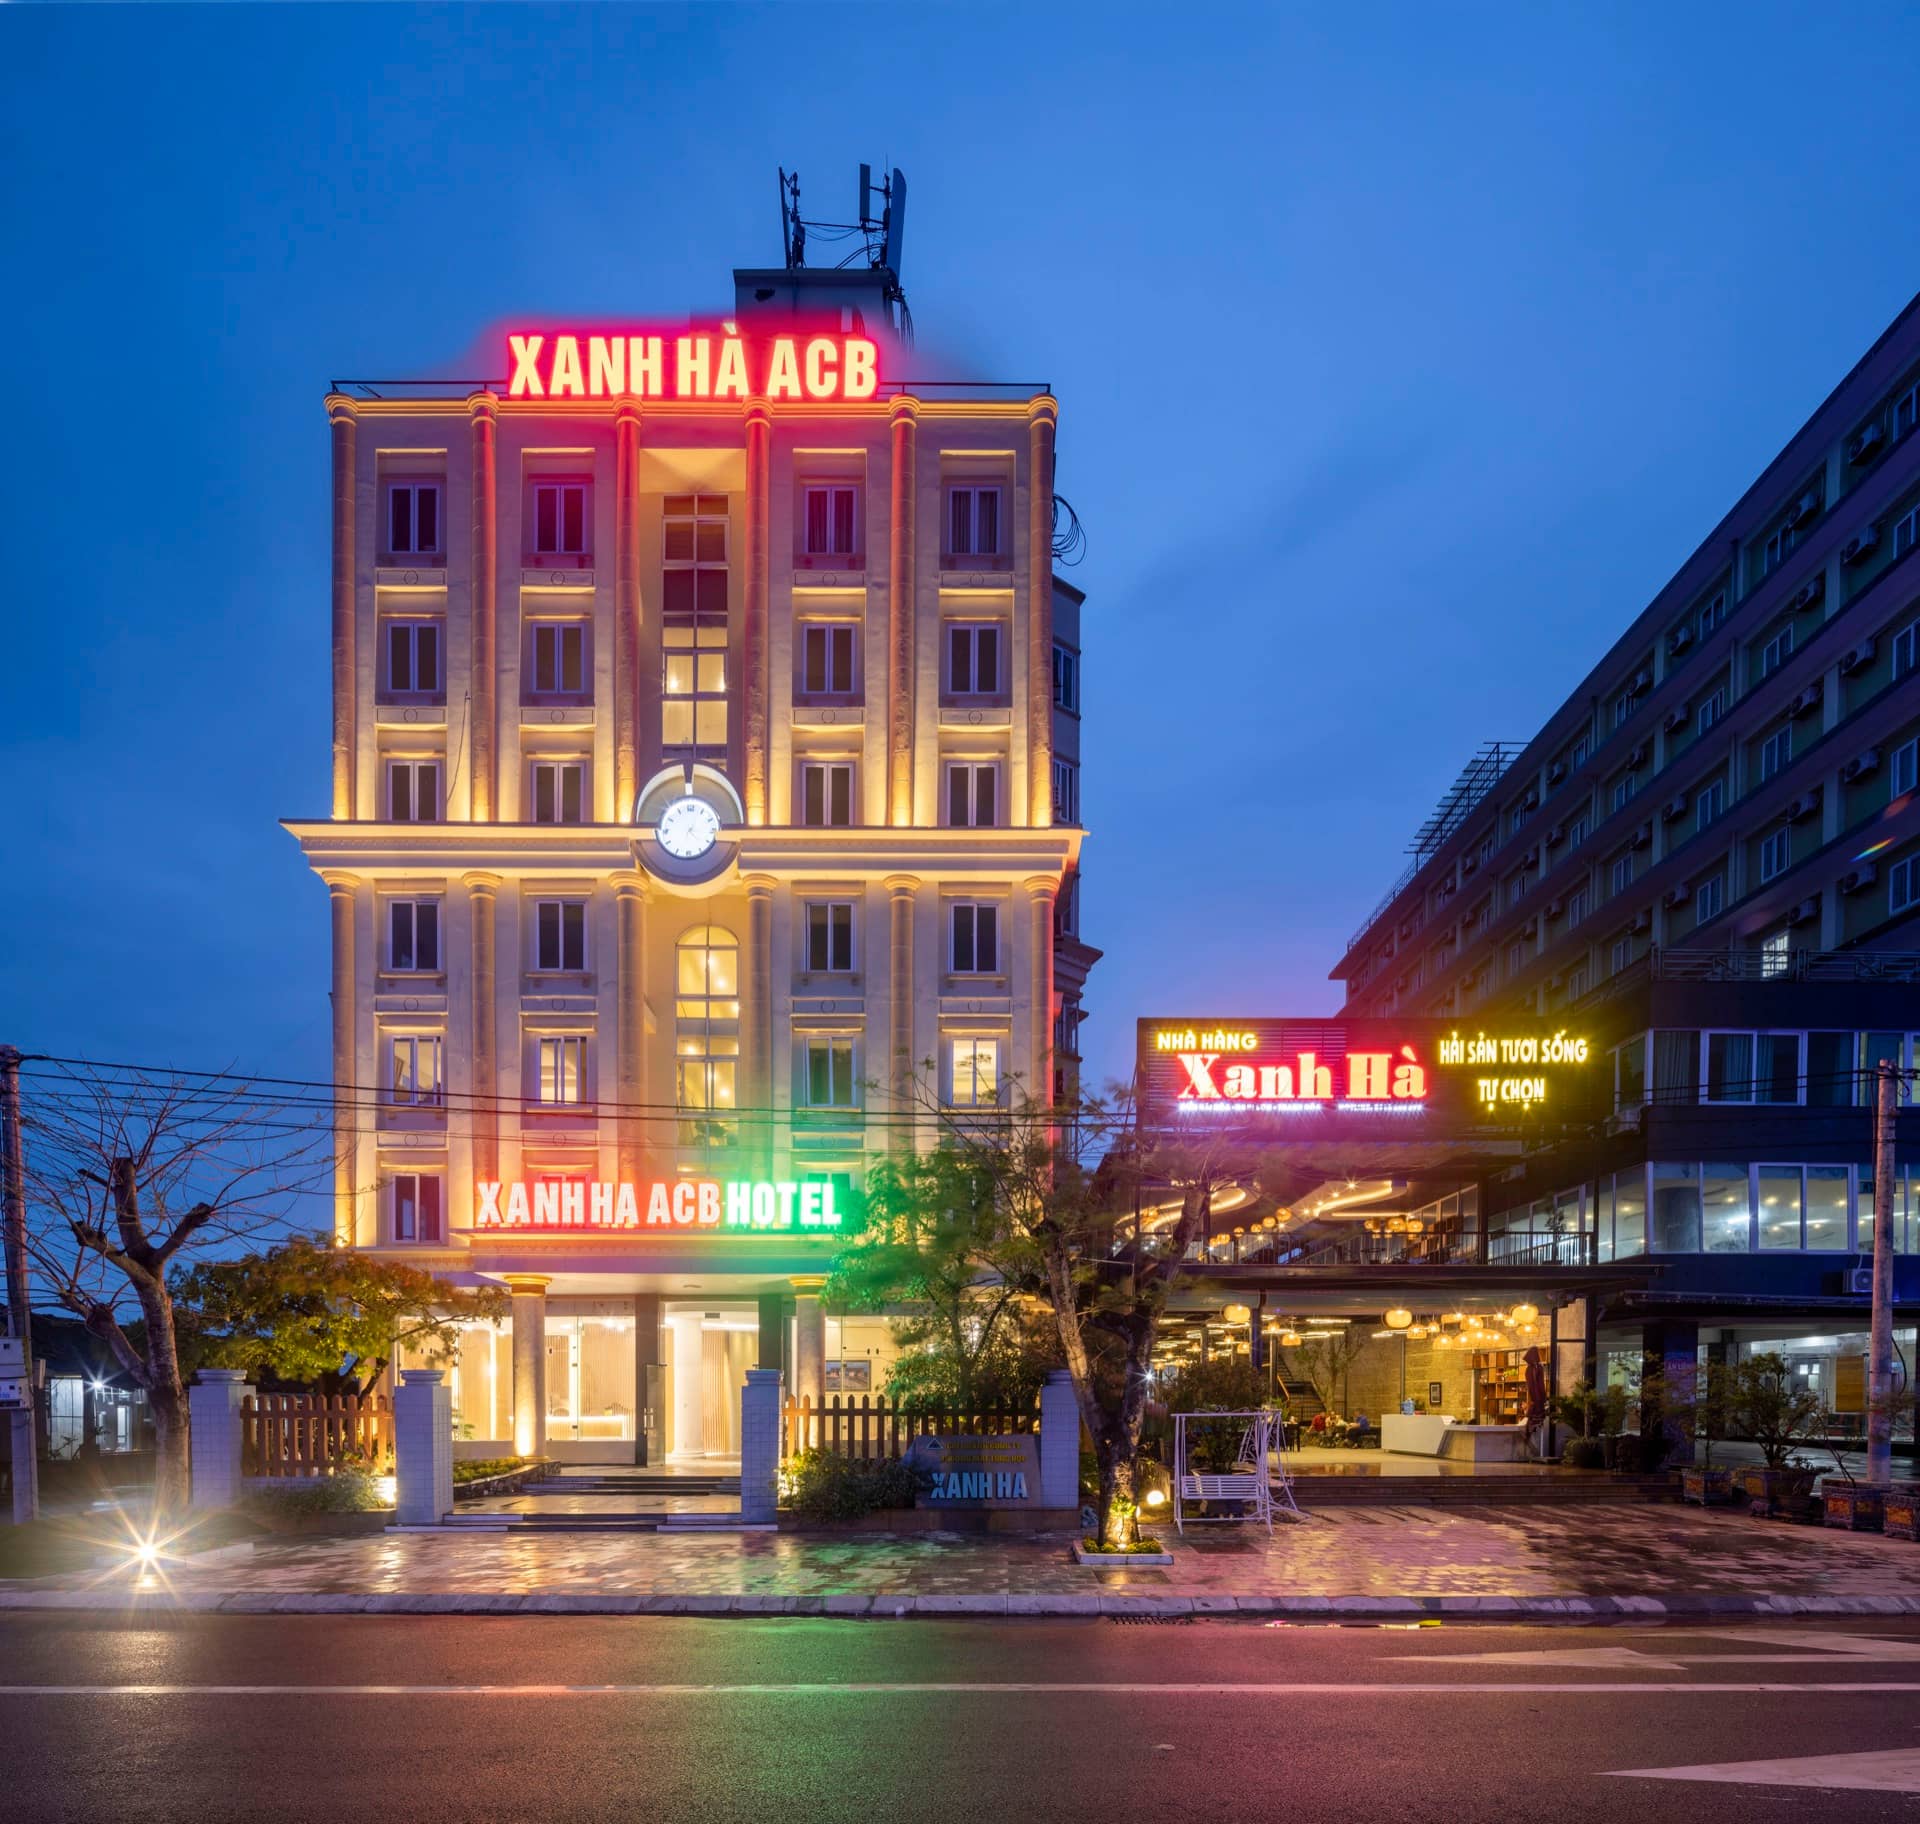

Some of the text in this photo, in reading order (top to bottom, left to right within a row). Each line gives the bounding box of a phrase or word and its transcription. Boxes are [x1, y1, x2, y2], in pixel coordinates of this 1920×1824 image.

[508, 322, 878, 398] XANH HÀ ACB
[1157, 1029, 1257, 1050] NHÀ HÀNG
[1439, 1031, 1465, 1064] HẢI
[1467, 1032, 1498, 1064] SẢN
[1541, 1029, 1588, 1064] SỐNG
[1177, 1045, 1427, 1099] Xanh Hà
[1501, 1078, 1545, 1111] CHỌN
[477, 1182, 842, 1225] XANH HA ACB HOTEL
[930, 1472, 1029, 1499] XANH HA
